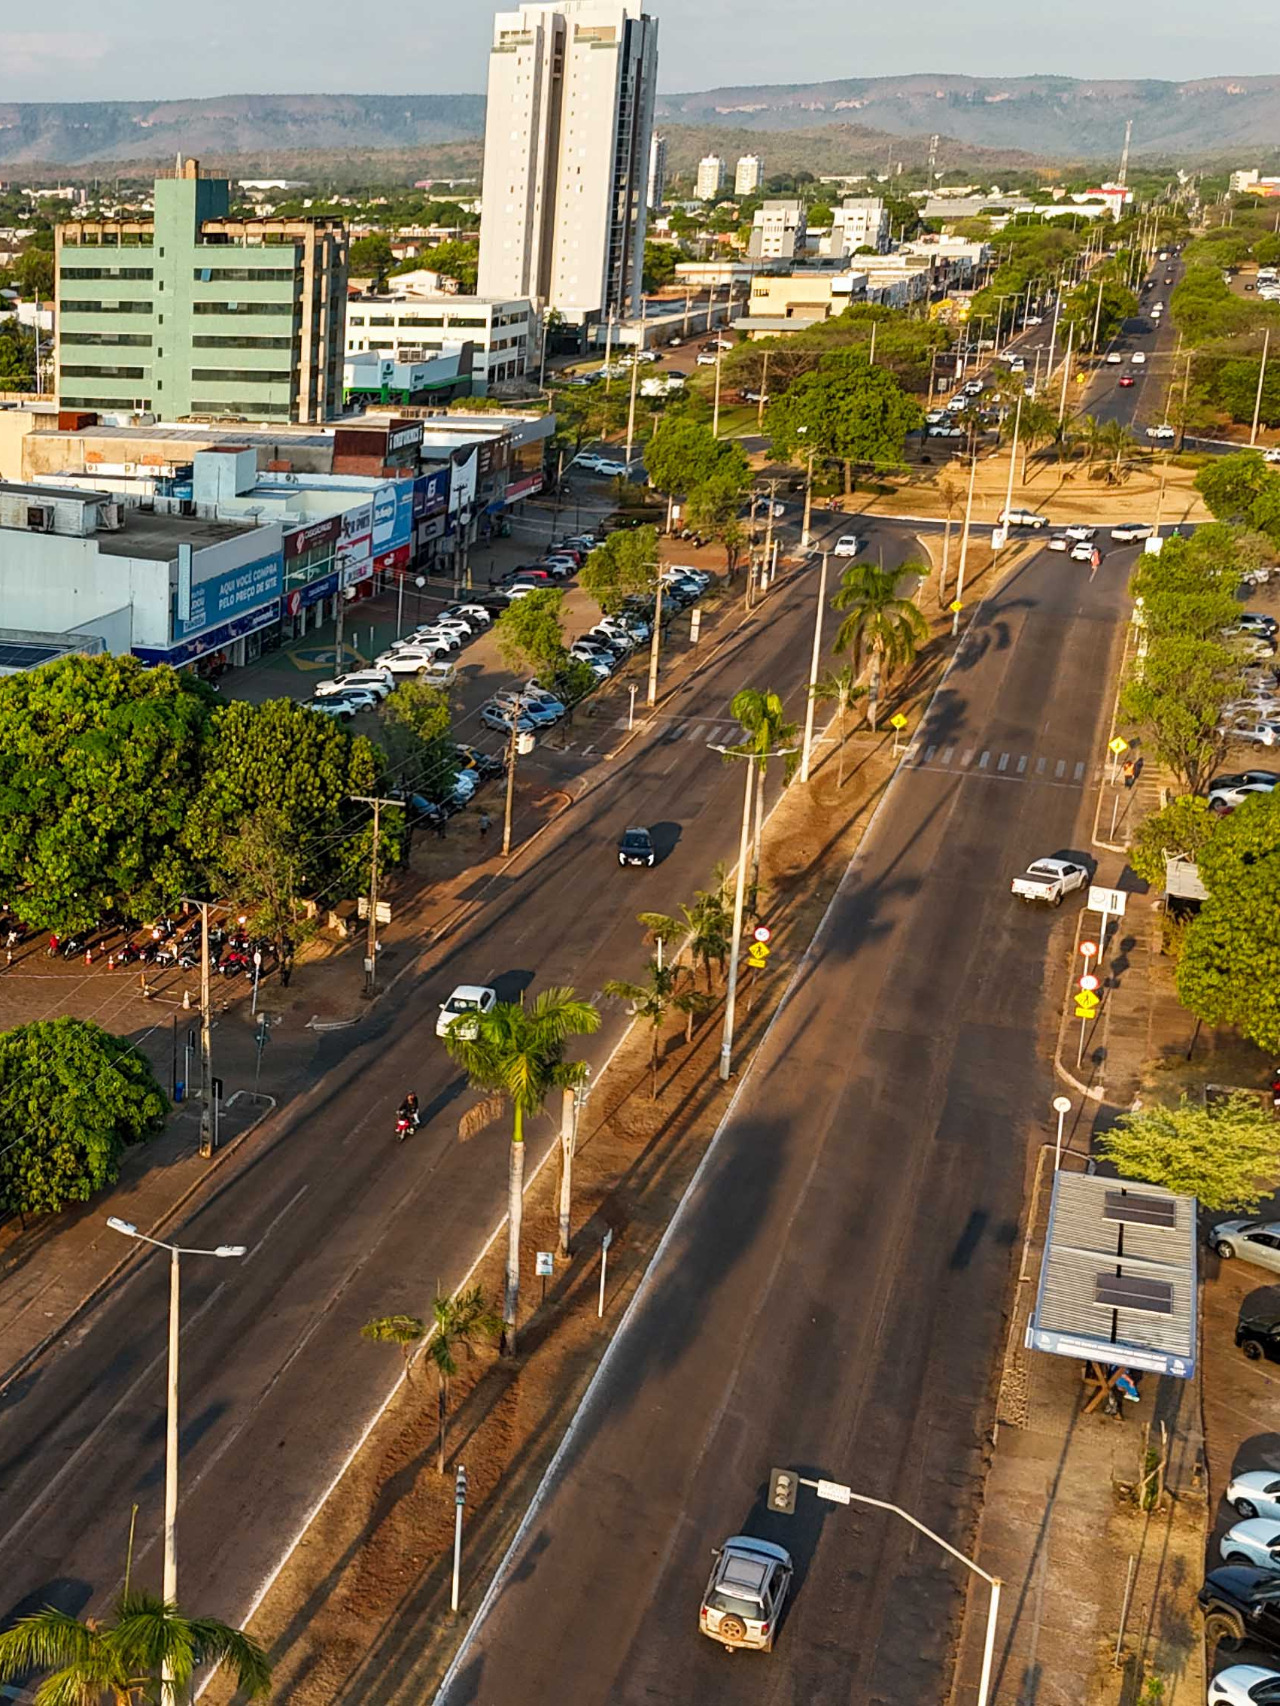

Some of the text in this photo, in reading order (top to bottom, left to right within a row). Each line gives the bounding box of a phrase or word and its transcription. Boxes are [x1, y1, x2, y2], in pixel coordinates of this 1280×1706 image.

[218, 576, 278, 611] PELO PREÇO DE SITE
[219, 581, 235, 597] AQUI
[253, 562, 278, 584] COMPRA
